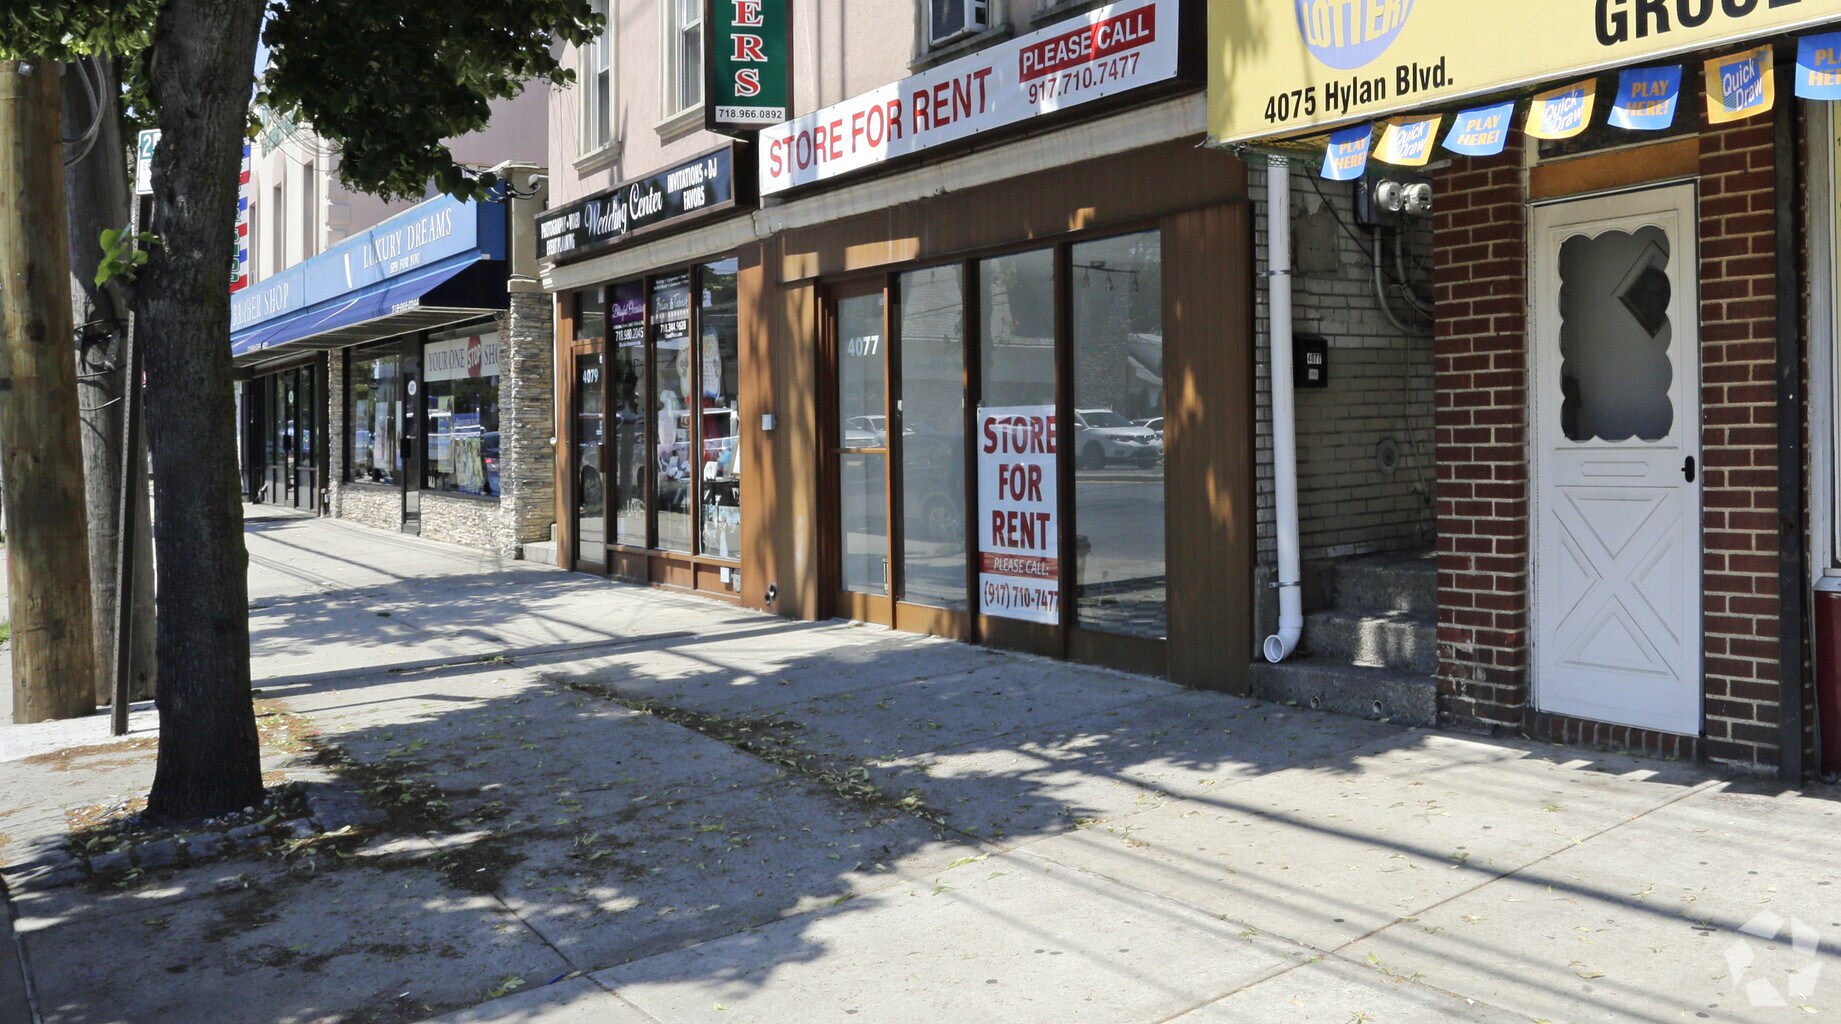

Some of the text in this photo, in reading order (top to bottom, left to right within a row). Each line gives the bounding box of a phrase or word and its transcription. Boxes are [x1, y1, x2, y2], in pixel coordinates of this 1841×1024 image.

[1023, 14, 1149, 75] PLEASE CALL
[1815, 47, 1841, 67] PL
[1029, 51, 1140, 104] 917.710.7477
[1264, 55, 1454, 124] 4075 Hylan Blvd.
[1632, 80, 1670, 98] PLAY
[1723, 57, 1755, 96] Quick
[1545, 90, 1578, 121] Quick
[1625, 98, 1670, 117] HERE!
[1735, 76, 1762, 112] Draw
[719, 109, 782, 120] 718.966.0892
[770, 66, 993, 178] STORE FOR RENT
[1466, 114, 1501, 132] PLAY
[1552, 105, 1584, 134] Draw
[1339, 137, 1366, 155] PLAY
[1395, 121, 1425, 145] Quick
[1457, 130, 1500, 146] HERE!
[1399, 139, 1426, 158] Draw
[667, 157, 718, 193] INVITATIONS DJ
[584, 183, 662, 237] Wedding Center
[683, 186, 705, 211] FAVORS
[363, 207, 452, 269] LUXURY DREAMS
[232, 282, 289, 327] BARBER SHOP
[428, 351, 449, 371] YOUR
[450, 348, 465, 369] ONE
[468, 344, 481, 369] STOP
[848, 334, 880, 356] 4077
[583, 368, 599, 384] 4079
[983, 416, 1056, 454] STORE
[998, 463, 1042, 502] FOR
[992, 510, 1050, 550] RENT
[994, 557, 1049, 576] PLEASE CALL:
[984, 580, 1010, 610] (917)
